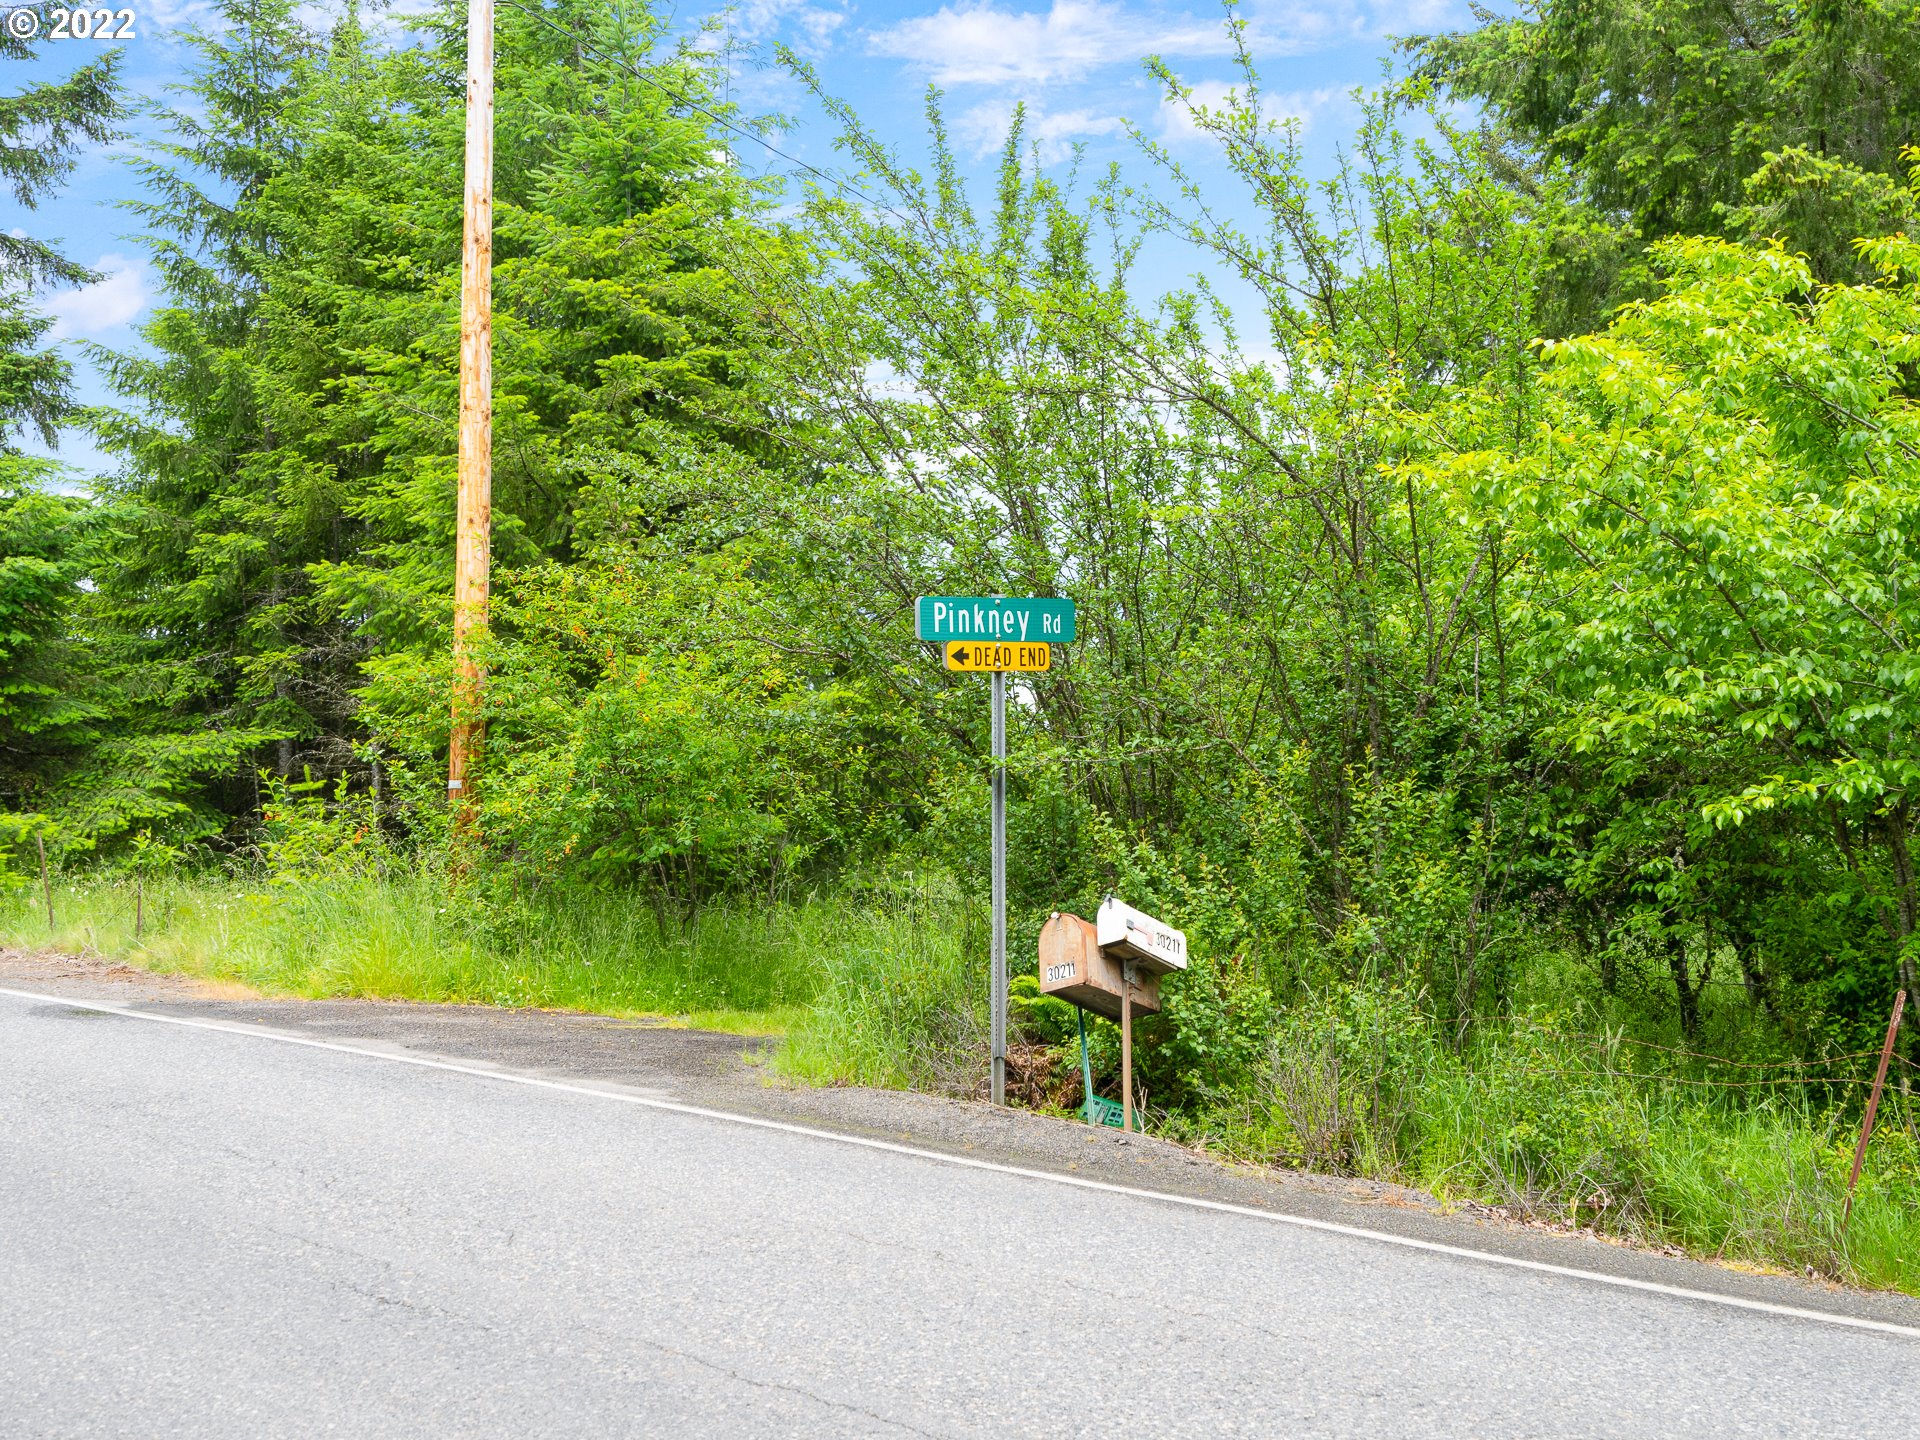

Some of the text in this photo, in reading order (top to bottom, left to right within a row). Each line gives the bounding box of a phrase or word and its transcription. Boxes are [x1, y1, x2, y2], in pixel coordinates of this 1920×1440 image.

[934, 602, 1061, 641] Pinkney Rd
[974, 647, 1046, 667] DEAD END
[1156, 932, 1181, 954] 30211
[1047, 962, 1076, 982] 30211
